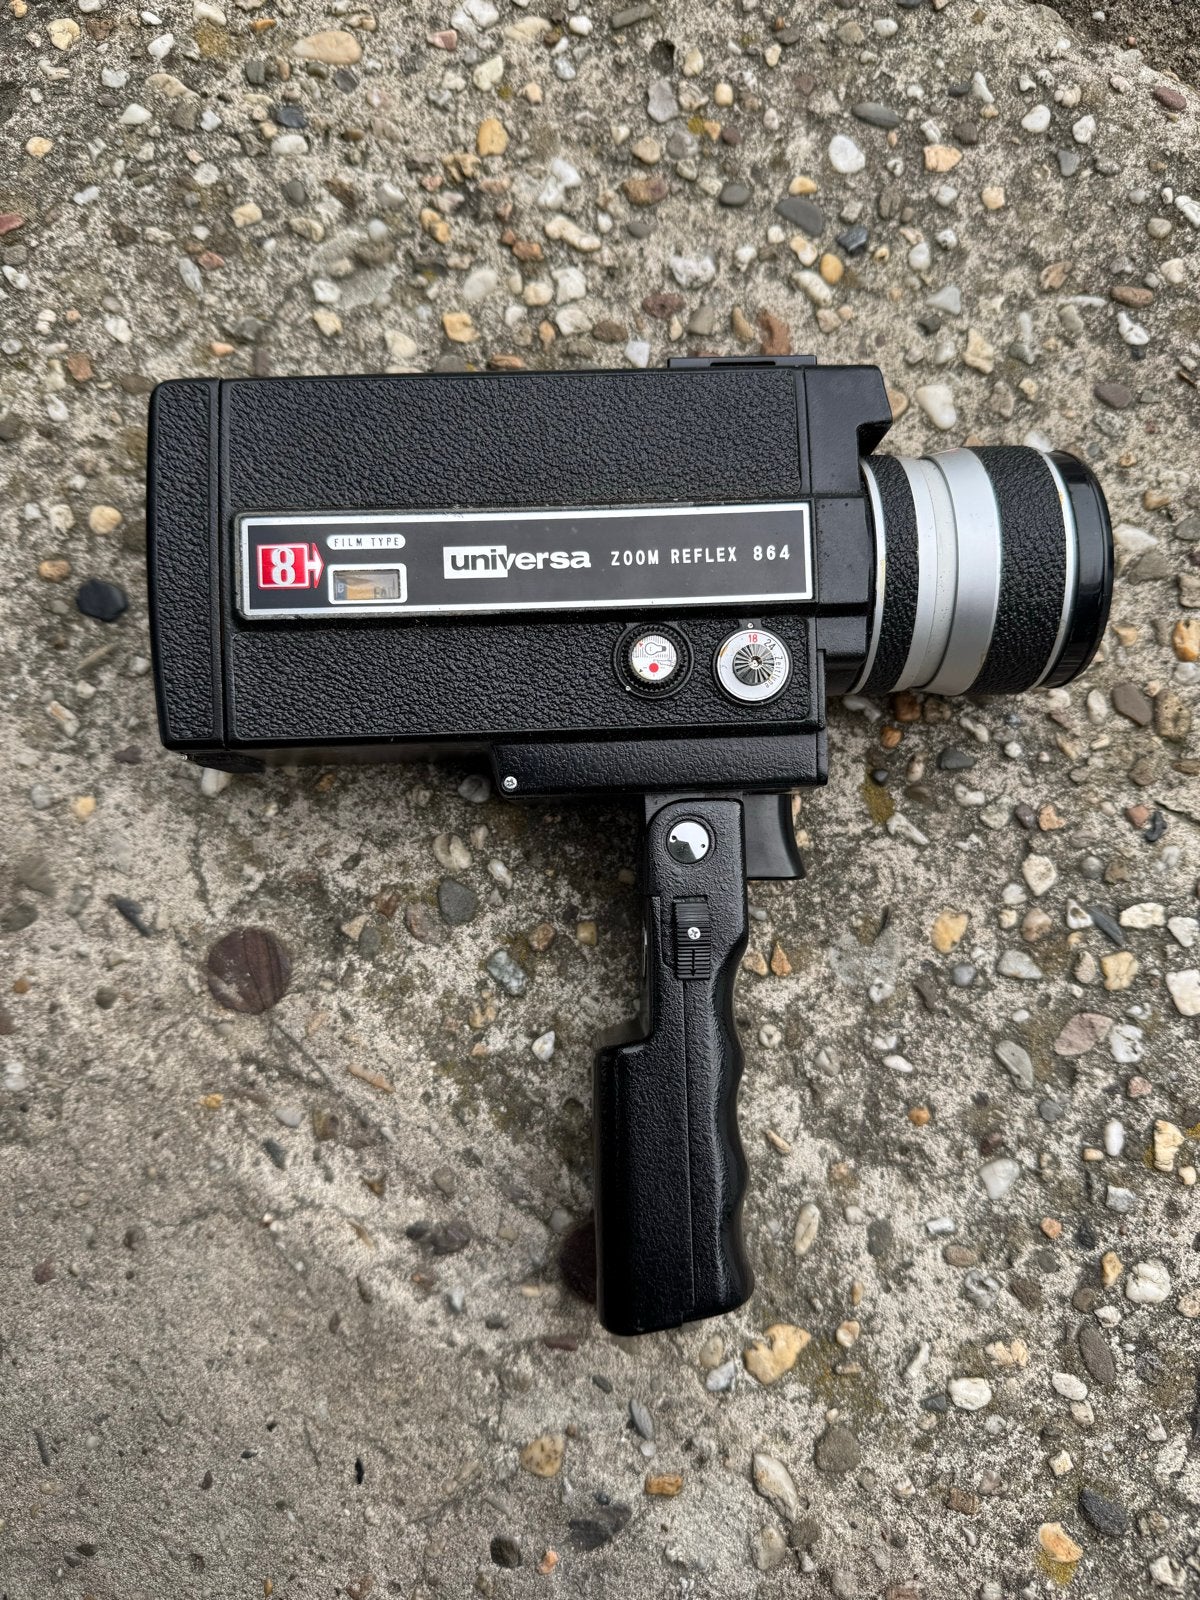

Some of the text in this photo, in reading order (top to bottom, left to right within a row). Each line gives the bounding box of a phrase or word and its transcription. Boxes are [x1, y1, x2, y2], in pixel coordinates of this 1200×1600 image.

[334, 536, 400, 548] FILM TYPE
[450, 548, 592, 571] universa
[610, 544, 791, 566] ZOOM REFLEX 864
[270, 546, 296, 586] 8
[748, 633, 758, 643] 18
[763, 638, 776, 651] 24
